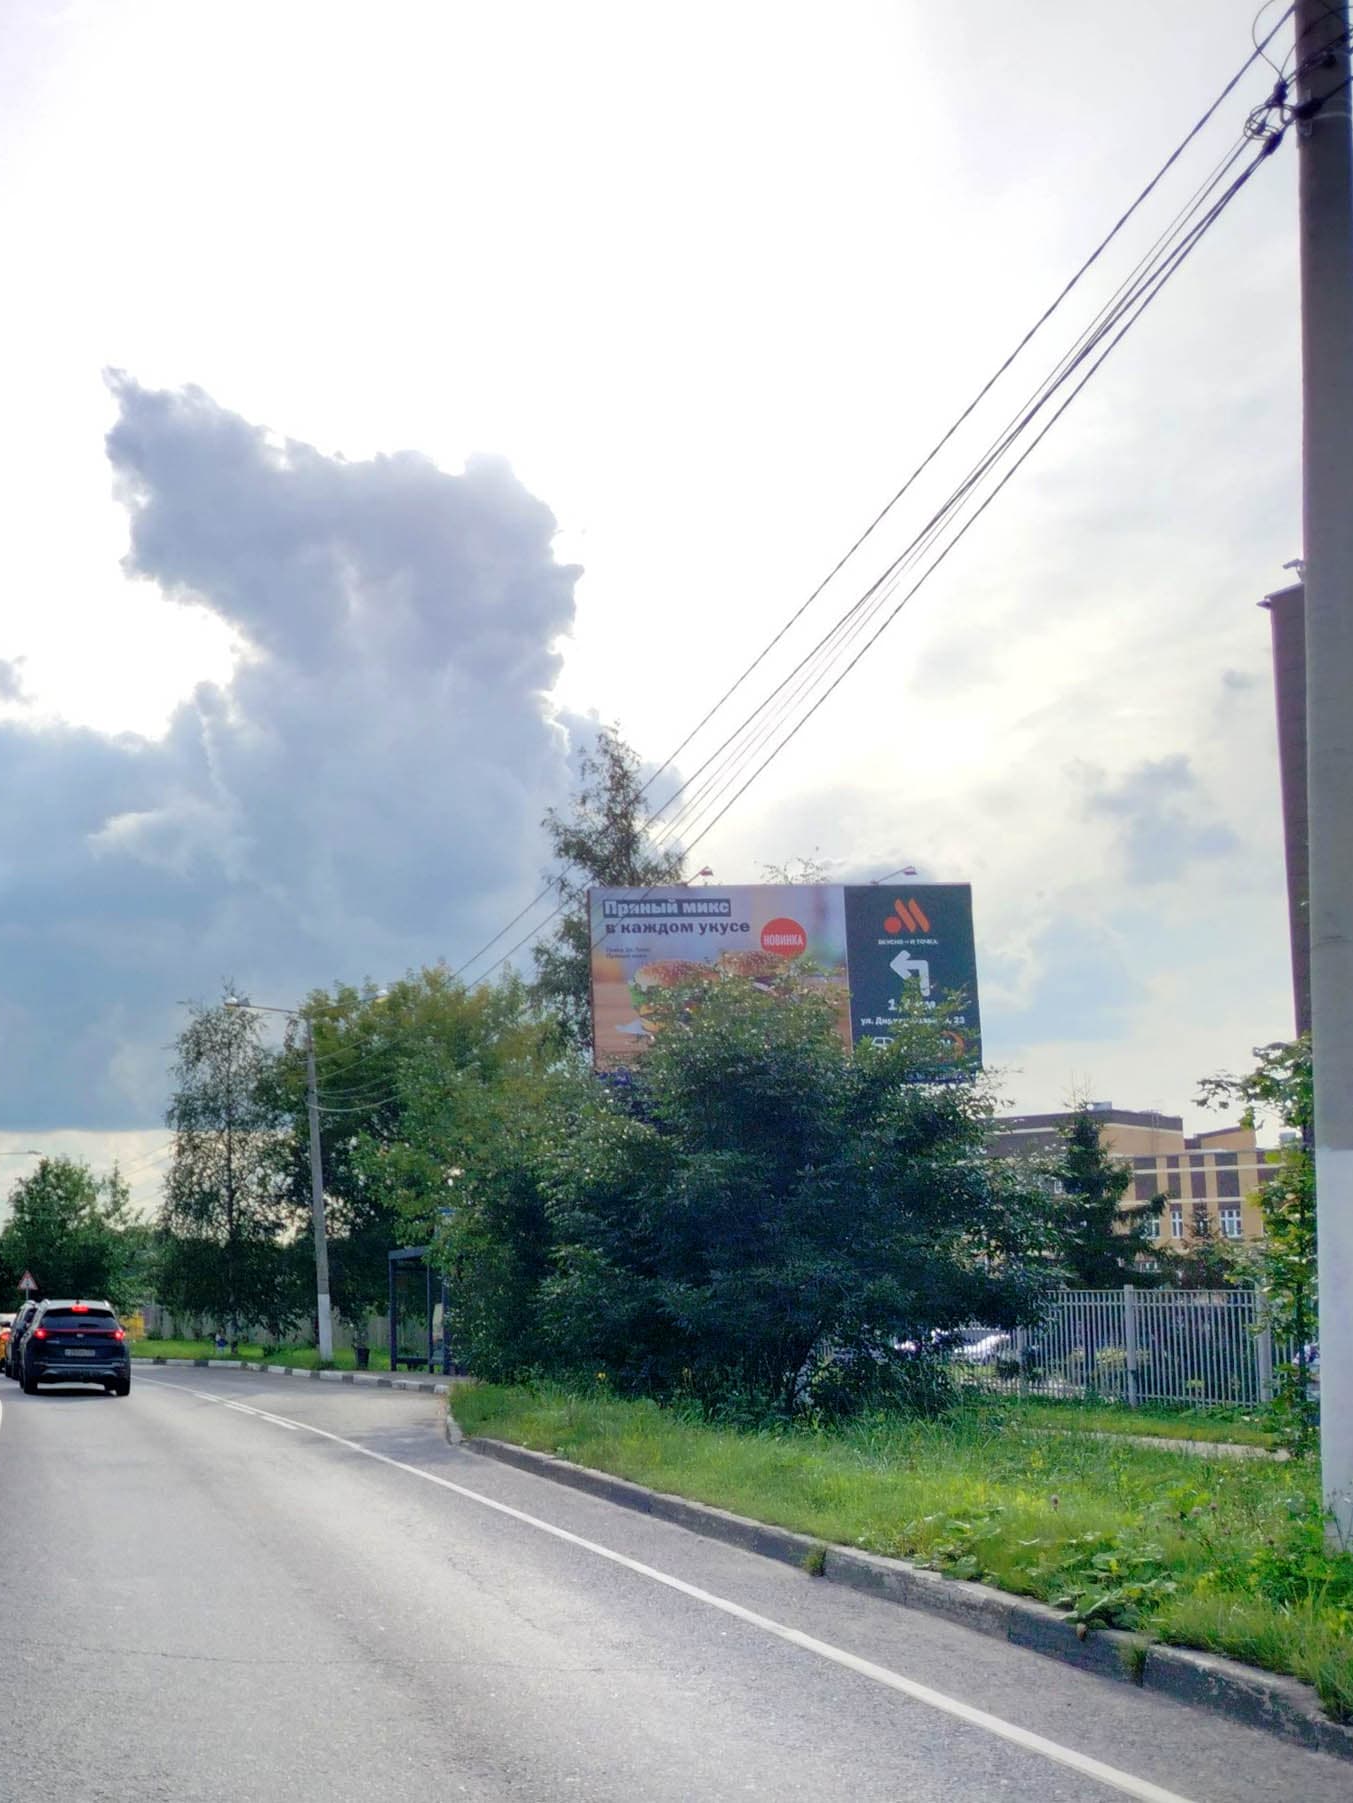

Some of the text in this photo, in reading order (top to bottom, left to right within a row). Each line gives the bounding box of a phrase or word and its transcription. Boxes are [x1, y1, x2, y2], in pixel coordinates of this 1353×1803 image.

[604, 899, 730, 917] Пряный микс
[605, 921, 751, 935] в каждом укусе
[763, 933, 804, 946] НОВИНКА
